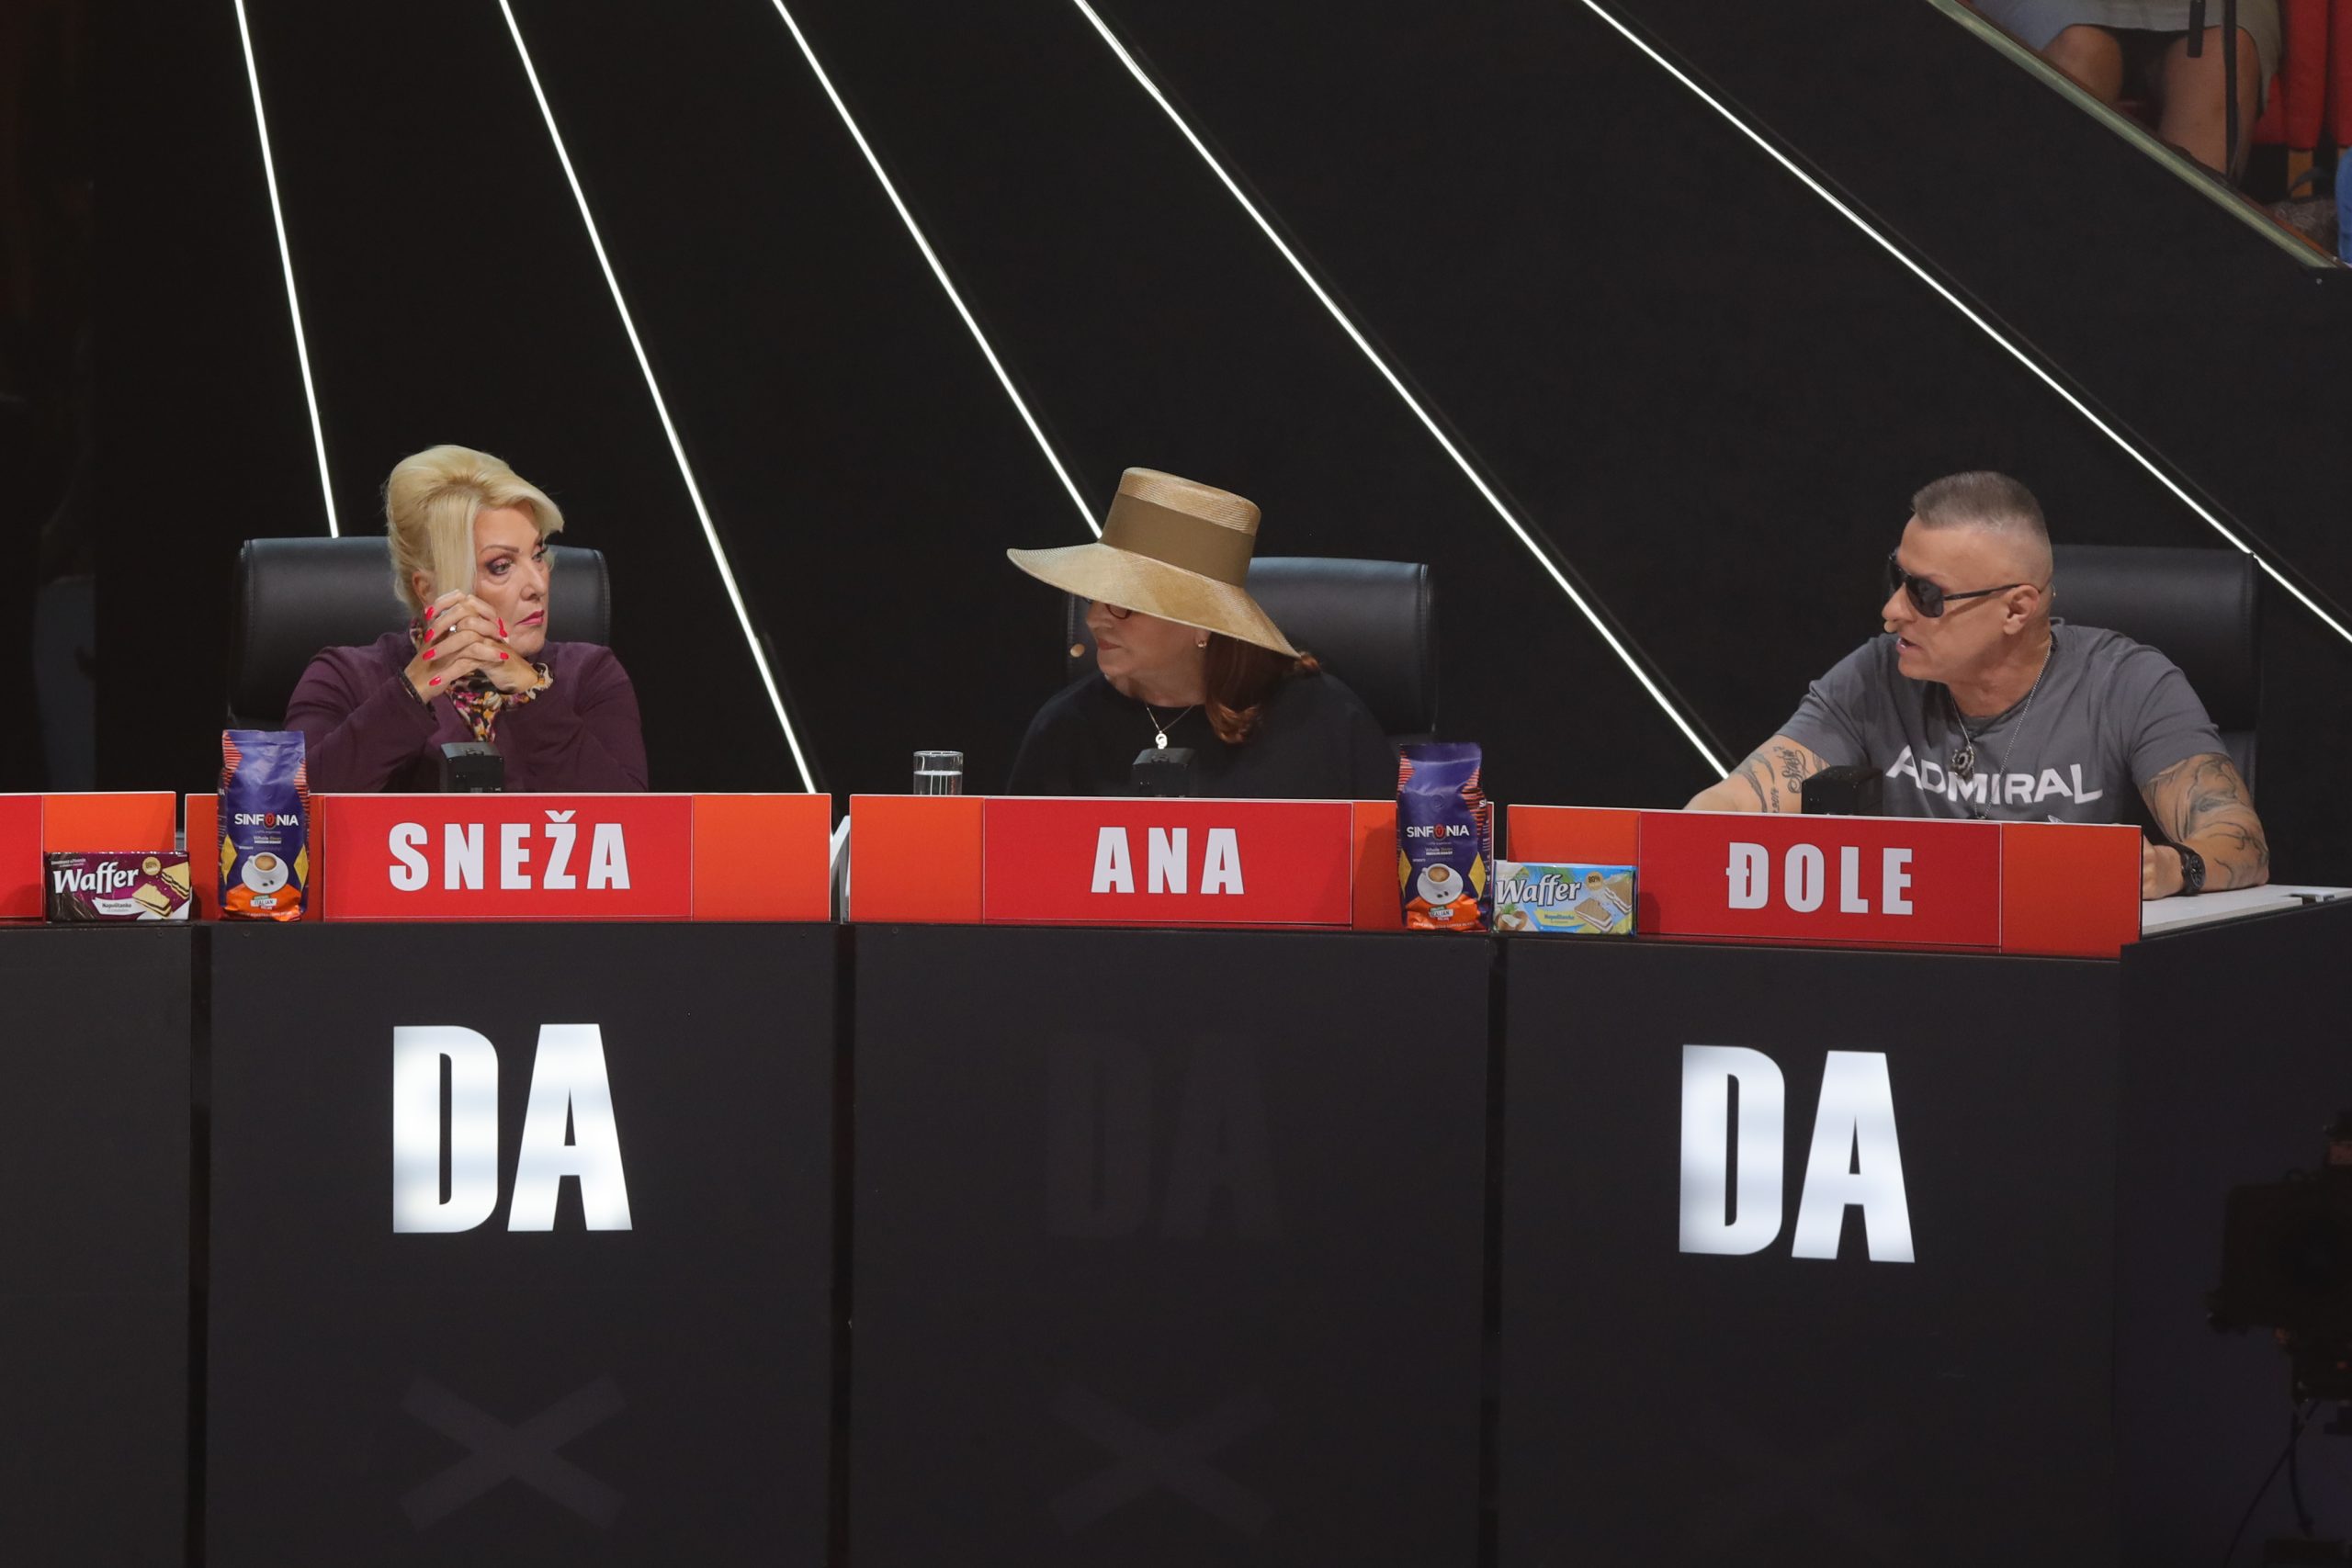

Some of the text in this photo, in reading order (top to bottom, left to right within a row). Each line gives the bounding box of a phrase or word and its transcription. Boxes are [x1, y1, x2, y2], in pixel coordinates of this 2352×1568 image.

[1886, 745, 2103, 805] ADMIRAL
[234, 813, 299, 829] SINFONIA
[389, 810, 631, 892] SNEŽA
[1407, 824, 1469, 840] SINFONIA
[53, 862, 139, 894] Waffer
[1091, 827, 1244, 895] ANA
[1496, 874, 1581, 907] Waffer
[1726, 842, 1914, 915] ĐOLE
[392, 1023, 633, 1234] DA
[1045, 1036, 1283, 1239] DA
[1679, 1044, 1916, 1263] DA
